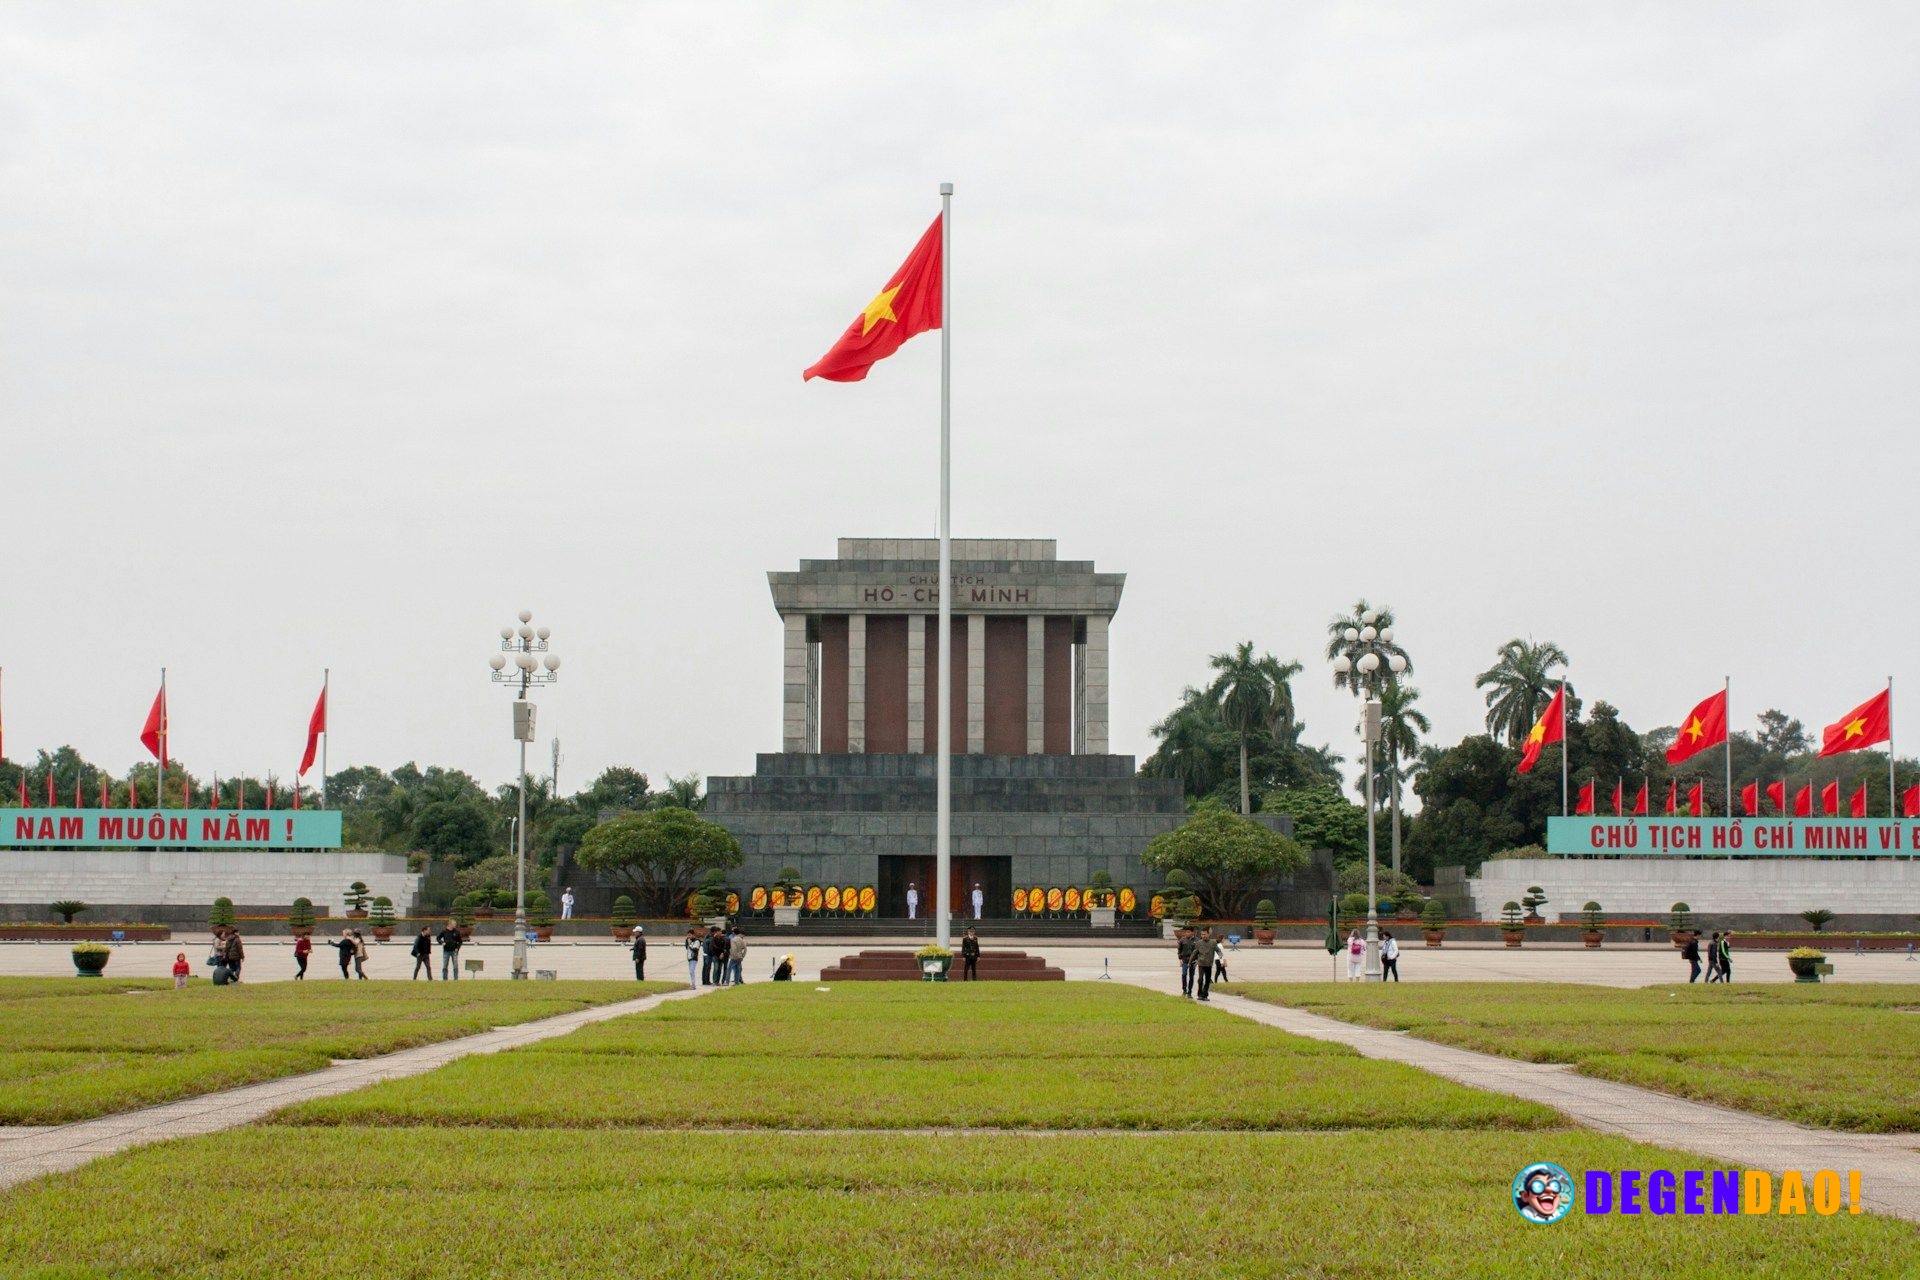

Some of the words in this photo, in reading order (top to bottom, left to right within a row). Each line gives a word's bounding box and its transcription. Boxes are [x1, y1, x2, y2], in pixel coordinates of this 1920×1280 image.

[16, 816, 84, 840] NAM
[98, 813, 188, 841] MUÔN
[202, 813, 270, 842] NĂM
[1590, 818, 1638, 849] CHỦ
[1648, 825, 1702, 853] TỊCH
[1712, 818, 1743, 849] HỒ
[1754, 821, 1794, 849] CHÍ
[1804, 826, 1868, 850] MINH
[1878, 821, 1901, 850] VĨ
